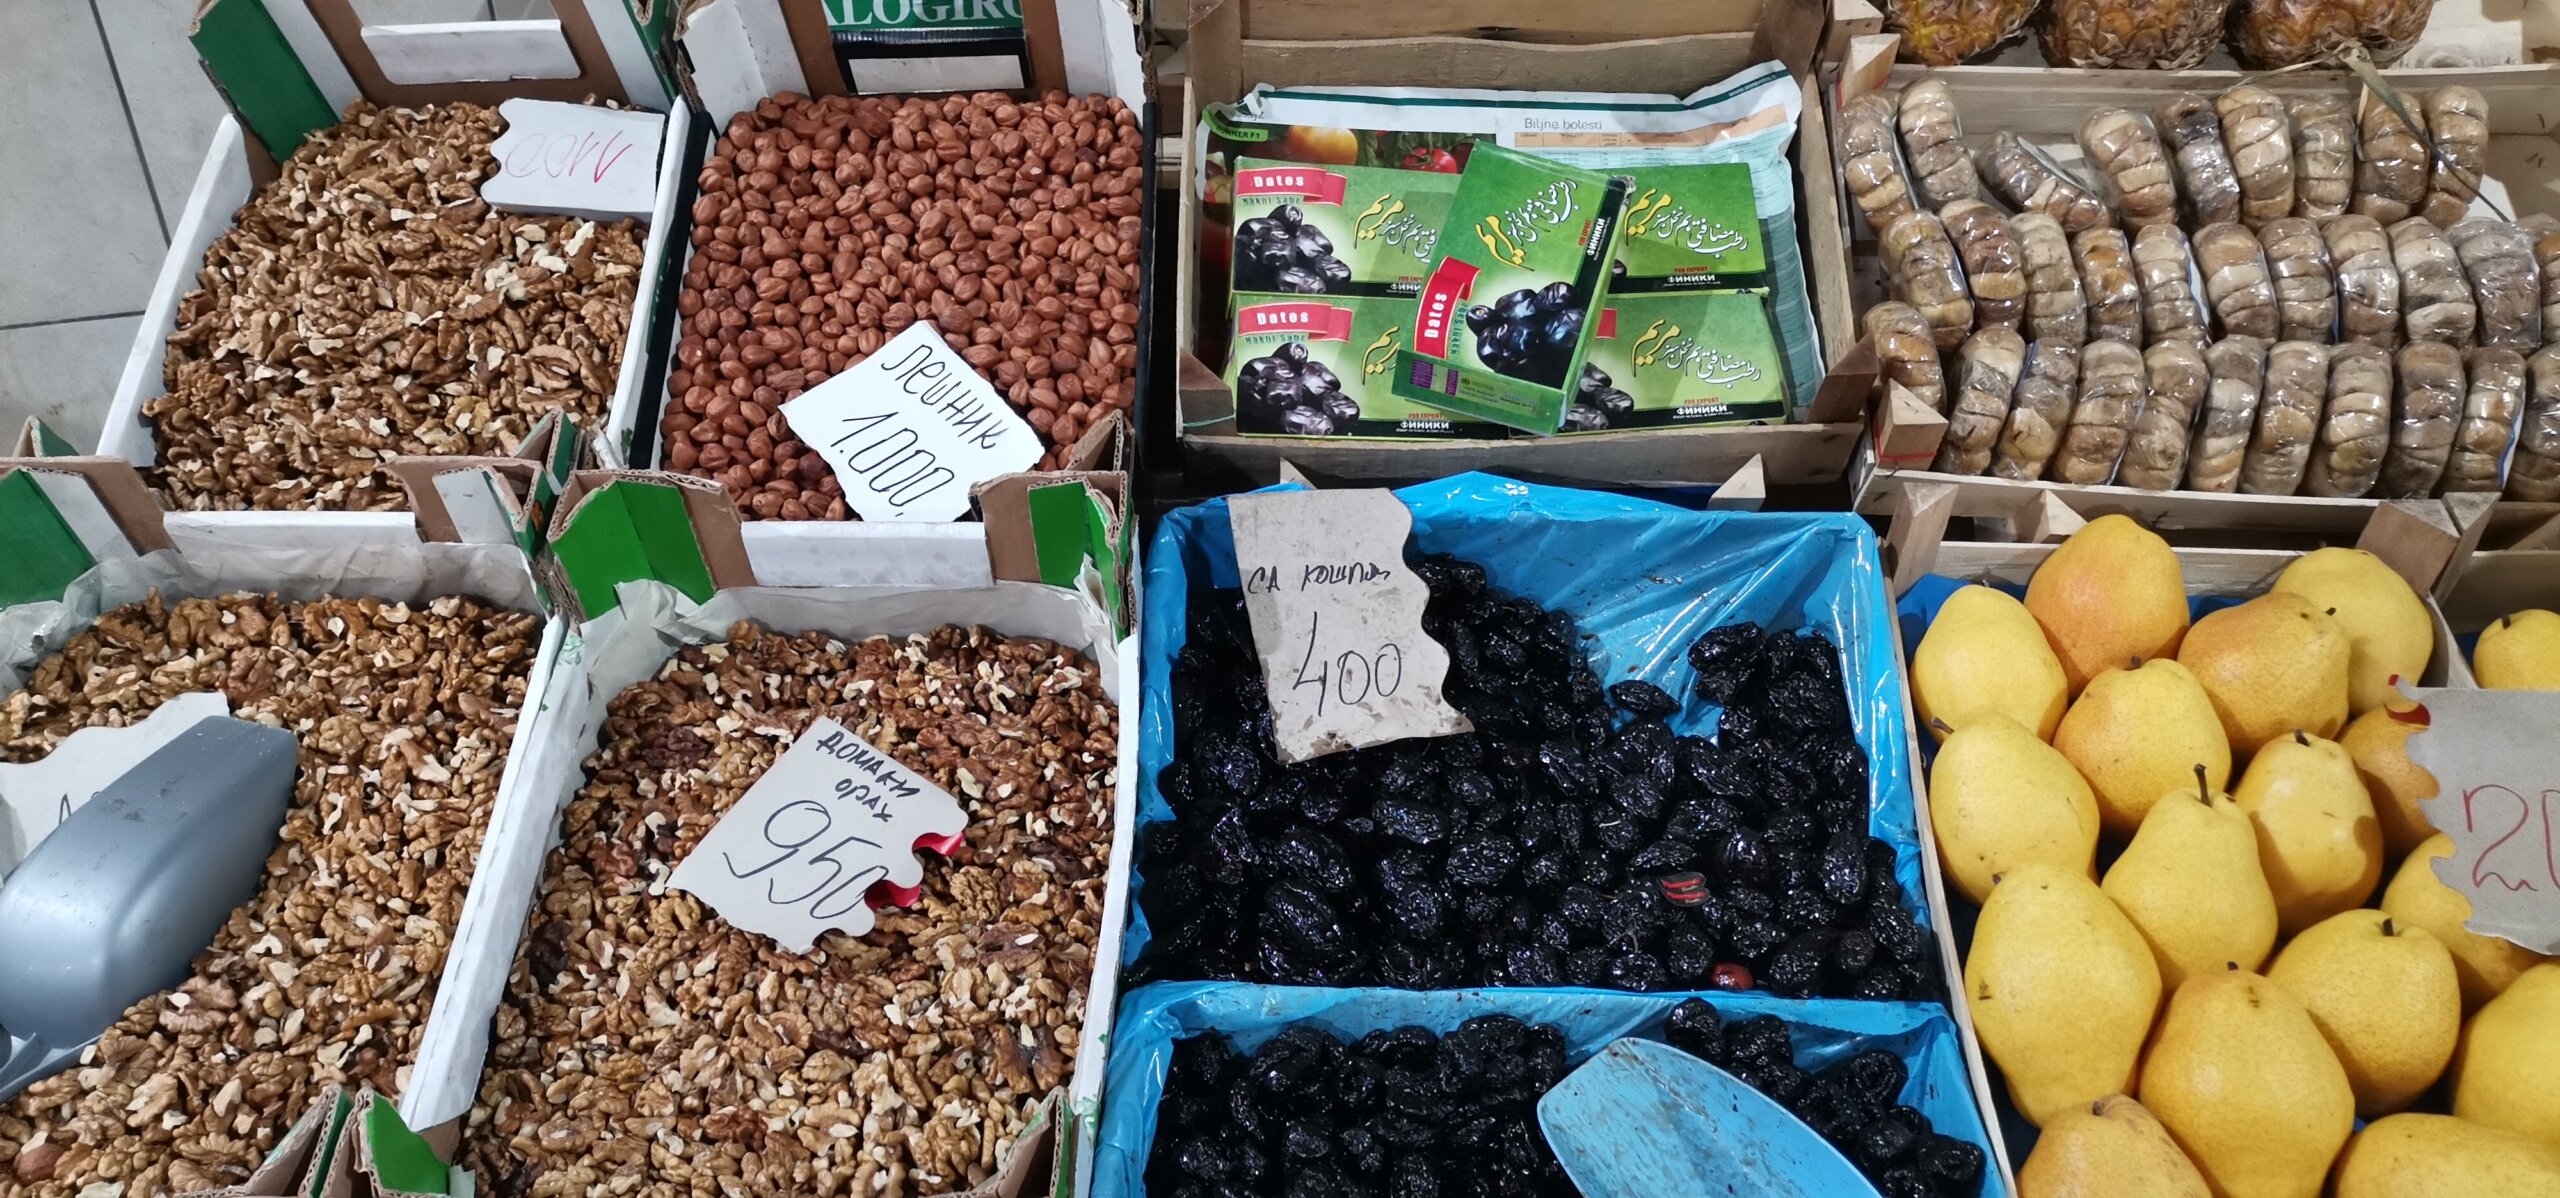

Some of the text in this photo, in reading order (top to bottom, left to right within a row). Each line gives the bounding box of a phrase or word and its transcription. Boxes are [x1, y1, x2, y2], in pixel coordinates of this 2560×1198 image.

[1524, 117, 1603, 131] Biljne bolesti
[1253, 175, 1305, 188] Dates
[1587, 217, 1606, 255] ФИНИКИ
[1667, 274, 1716, 283] ФИНИКИ
[1256, 311, 1309, 325] Dates
[1424, 293, 1448, 339] Dates
[1676, 404, 1728, 415] ФИНИКИ
[1400, 421, 1450, 429] ФИНИКИ
[1292, 611, 1402, 717] 400
[722, 800, 889, 919] 950
